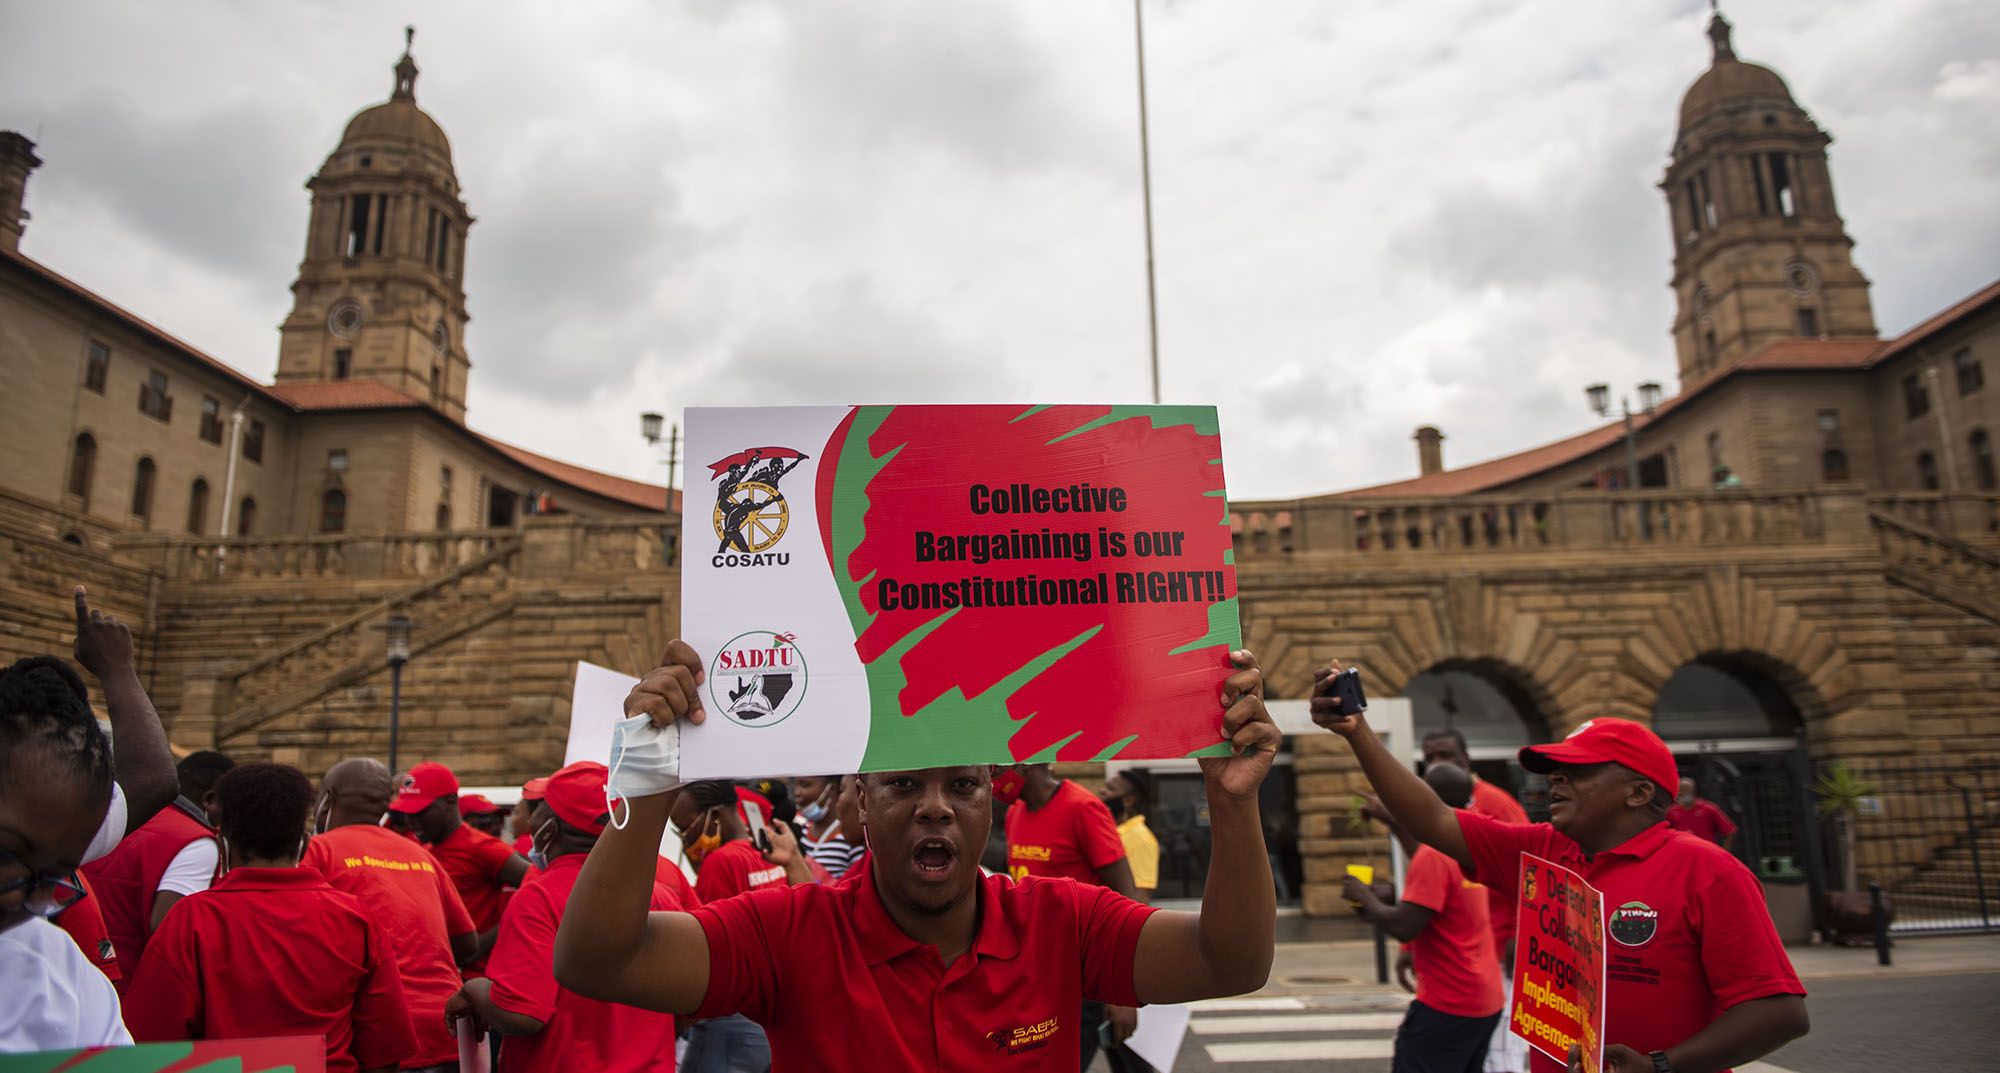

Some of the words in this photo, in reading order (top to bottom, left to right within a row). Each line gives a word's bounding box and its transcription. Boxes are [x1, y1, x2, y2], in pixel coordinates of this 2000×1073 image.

[970, 483, 1127, 515] Collective
[916, 528, 1092, 565] Bargaining
[1099, 528, 1127, 557] is
[1134, 531, 1185, 557] our
[712, 553, 790, 568] COSATU
[878, 573, 1109, 612] Constitutional
[1116, 571, 1226, 604] RIGHT!!
[720, 648, 793, 670] SADTU
[344, 856, 362, 868] We
[1011, 844, 1051, 858] SAEPU
[1547, 868, 1587, 919] Defend
[1540, 903, 1592, 963] Collective
[1013, 1016, 1058, 1039] SAEPU
